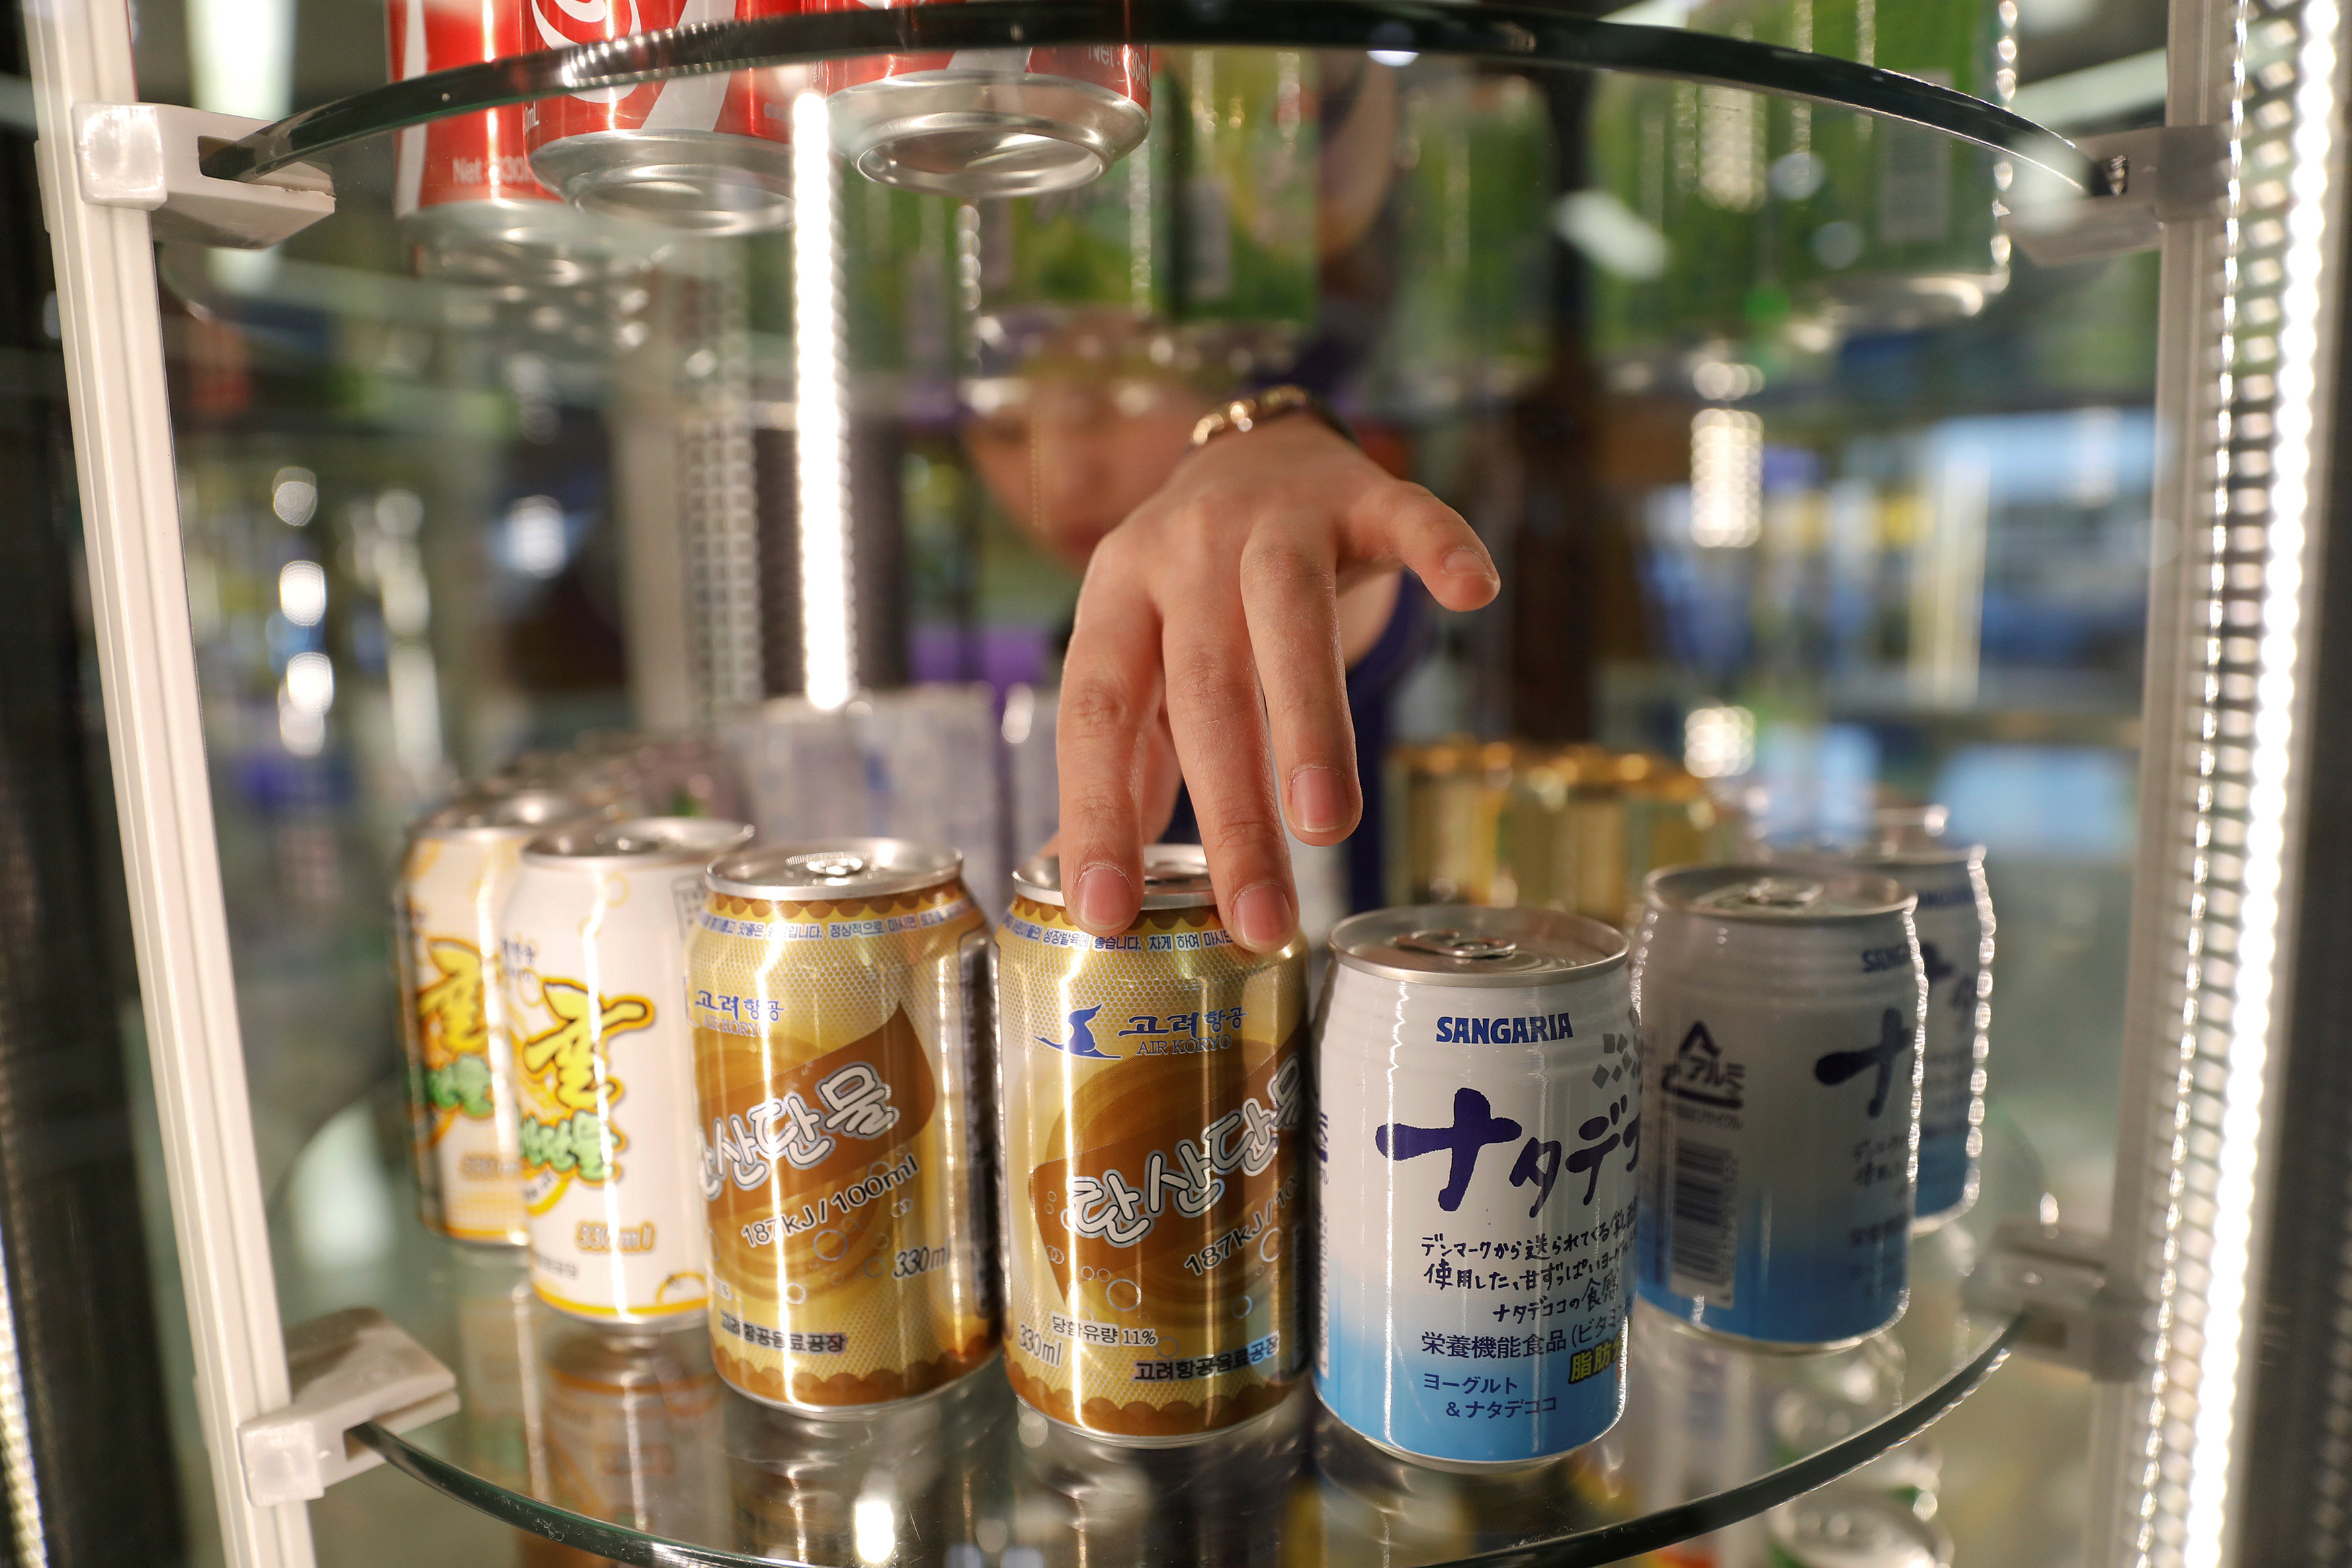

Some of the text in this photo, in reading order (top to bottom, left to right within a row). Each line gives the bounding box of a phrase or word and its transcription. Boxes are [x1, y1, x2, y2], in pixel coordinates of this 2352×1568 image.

[767, 924, 823, 939] 입니다.
[830, 920, 885, 939] 정상적으로
[886, 915, 918, 933] 마시면
[1094, 936, 1142, 951] 좋습니다.
[1149, 936, 1172, 951] 차게
[1176, 932, 1200, 949] 하여
[1118, 1006, 1248, 1038] 고려항공
[1435, 1012, 1574, 1045] SANGARIA
[1136, 1033, 1232, 1055] AIR KORYO
[742, 1154, 919, 1247] 187kJ/100ml
[579, 1224, 652, 1250] 33ml
[1019, 1323, 1062, 1366] 330ml
[1052, 1316, 1157, 1346] 당함유량 11%
[1423, 1373, 1519, 1395] ヨーグルト
